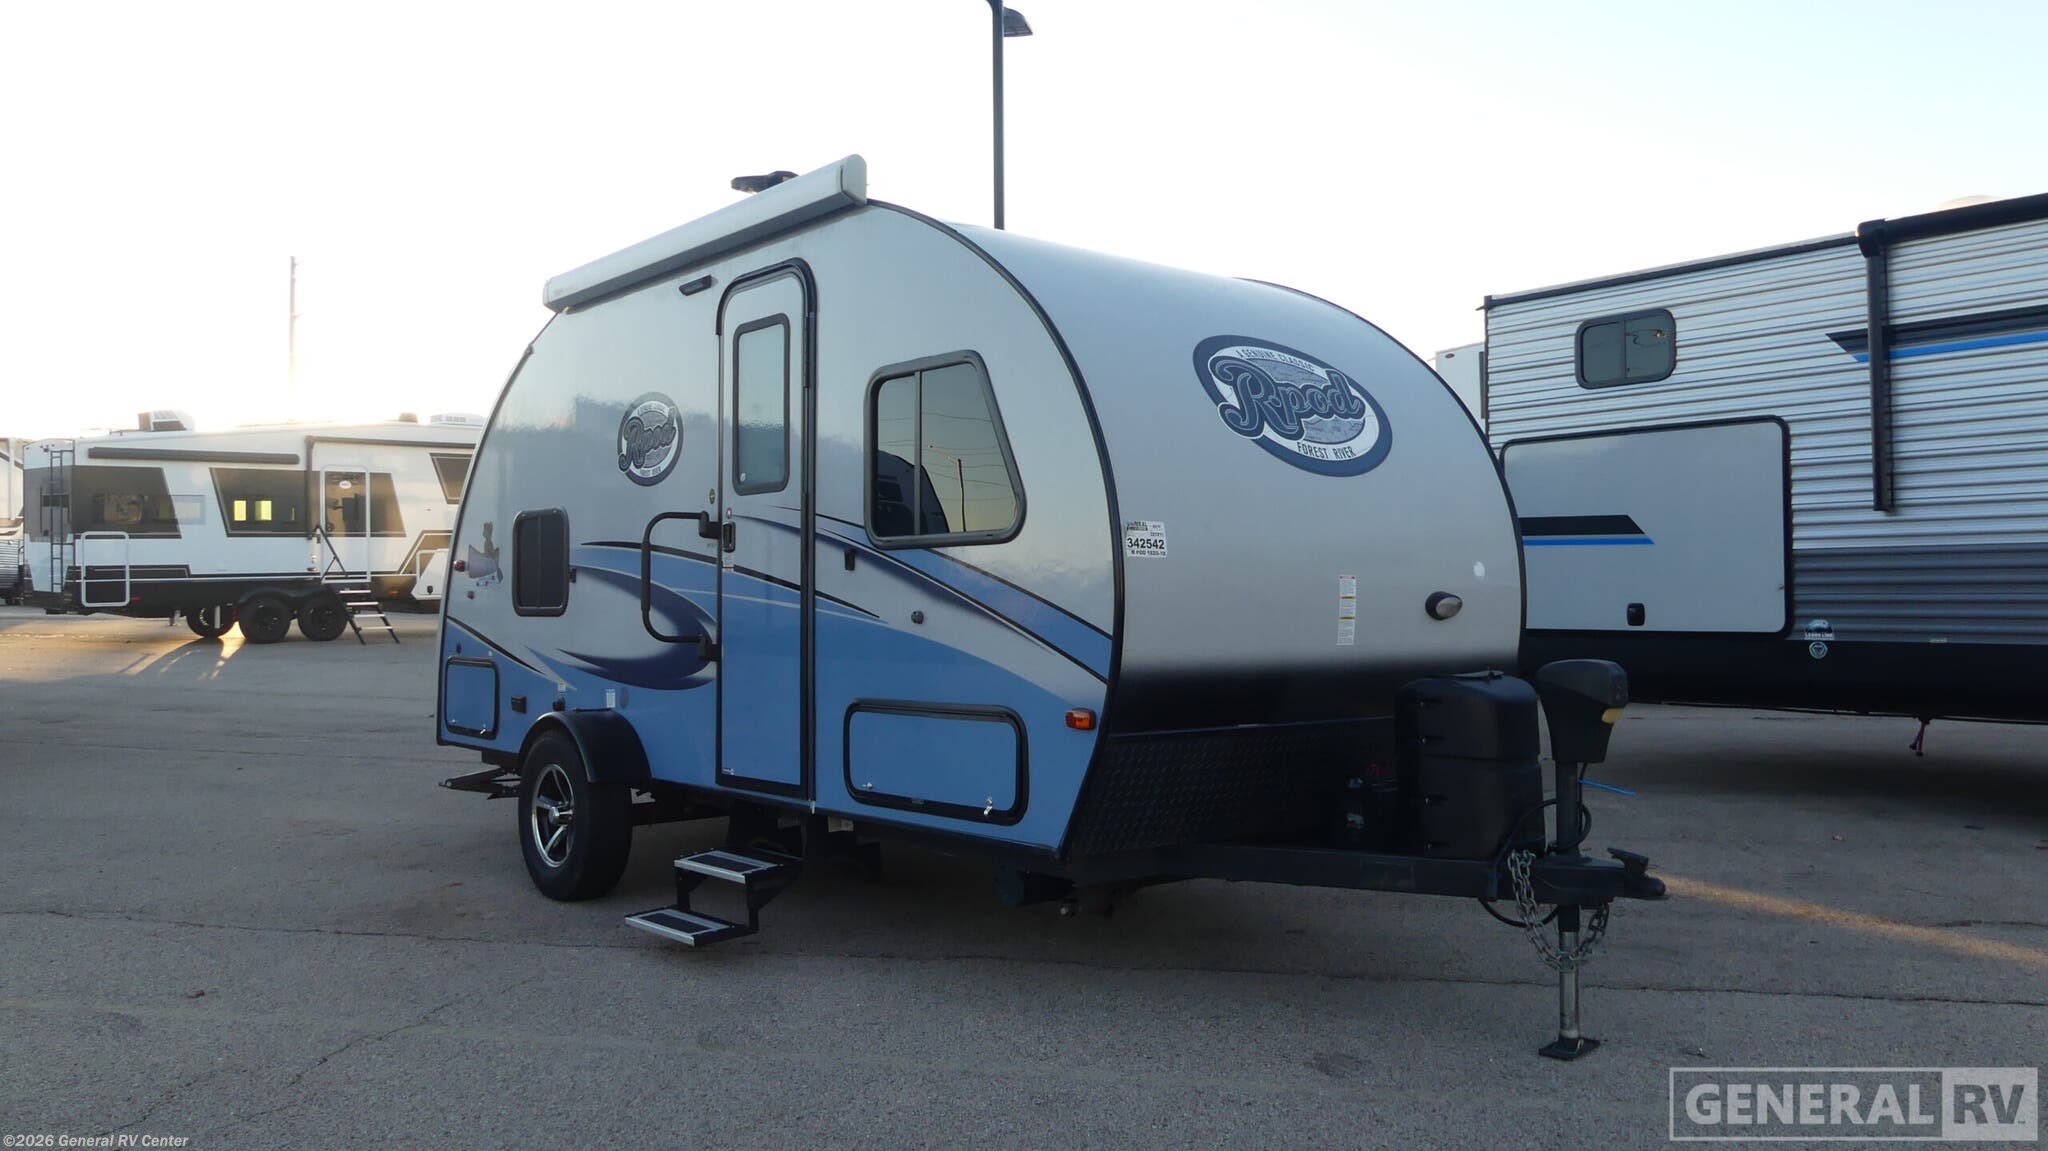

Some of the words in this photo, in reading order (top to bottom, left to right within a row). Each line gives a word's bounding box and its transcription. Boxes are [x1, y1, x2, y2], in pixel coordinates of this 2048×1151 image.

[1297, 441, 1329, 459] FOREST
[1332, 446, 1356, 459] RIVER
[1127, 537, 1165, 550] 342542
